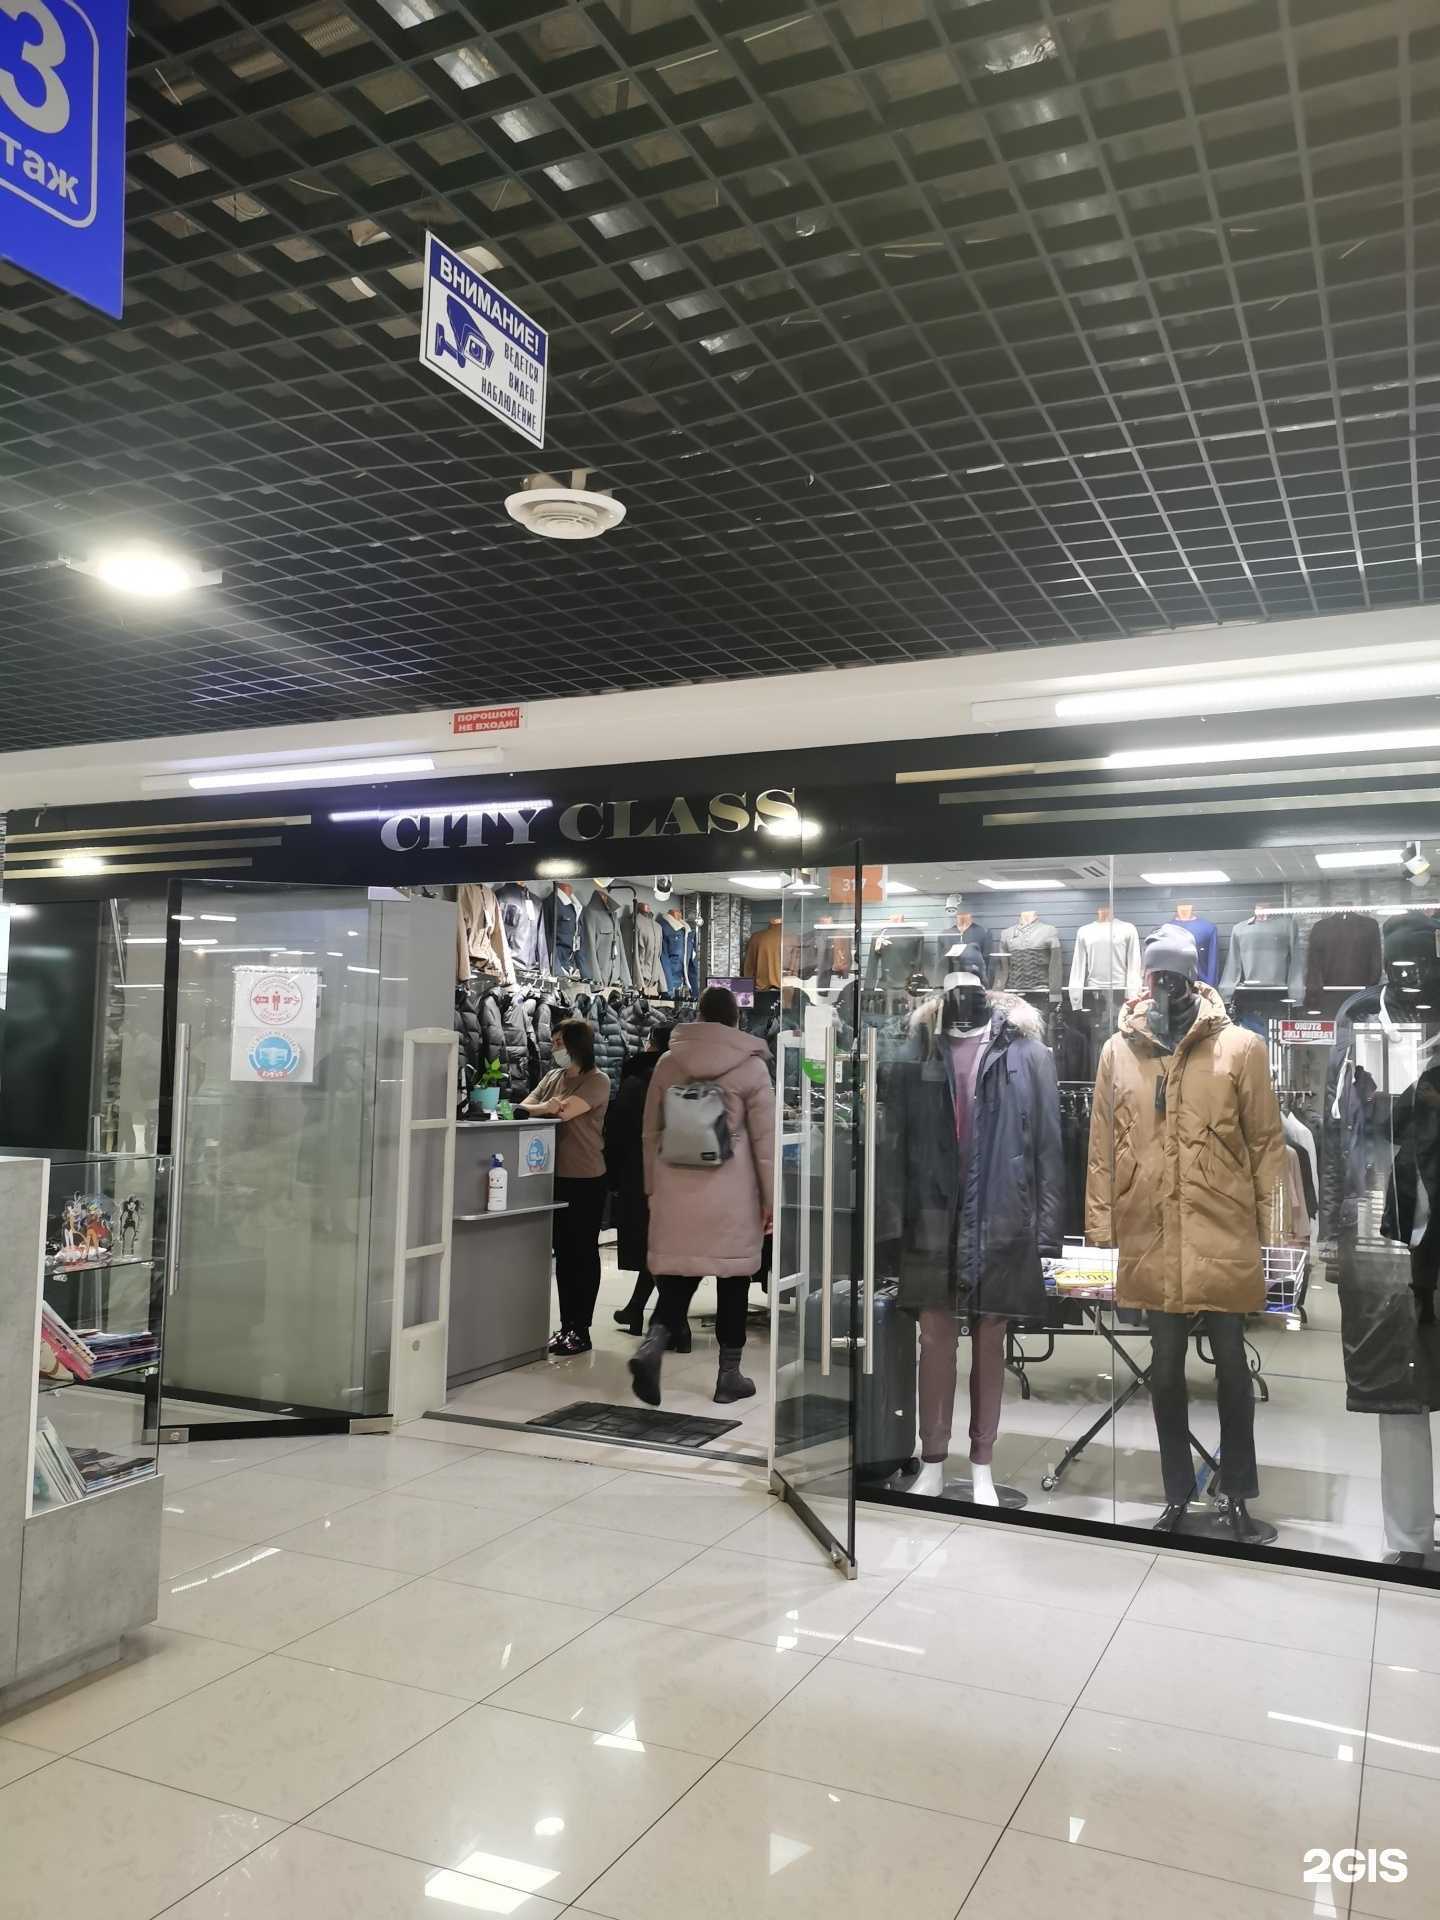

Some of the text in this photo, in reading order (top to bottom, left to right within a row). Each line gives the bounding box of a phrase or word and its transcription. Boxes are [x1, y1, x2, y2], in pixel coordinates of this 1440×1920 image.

[0, 0, 70, 134] 3
[440, 254, 540, 356] ВНИМАНИЕ!
[504, 341, 539, 384] ВЕДЕТСЯ
[481, 375, 537, 432] НАБЛЮДЕНИЕ
[457, 709, 519, 722] ПОРОШОК!
[458, 719, 517, 732] НЕ ВХОДИ!
[380, 787, 799, 852] CITY CLASS
